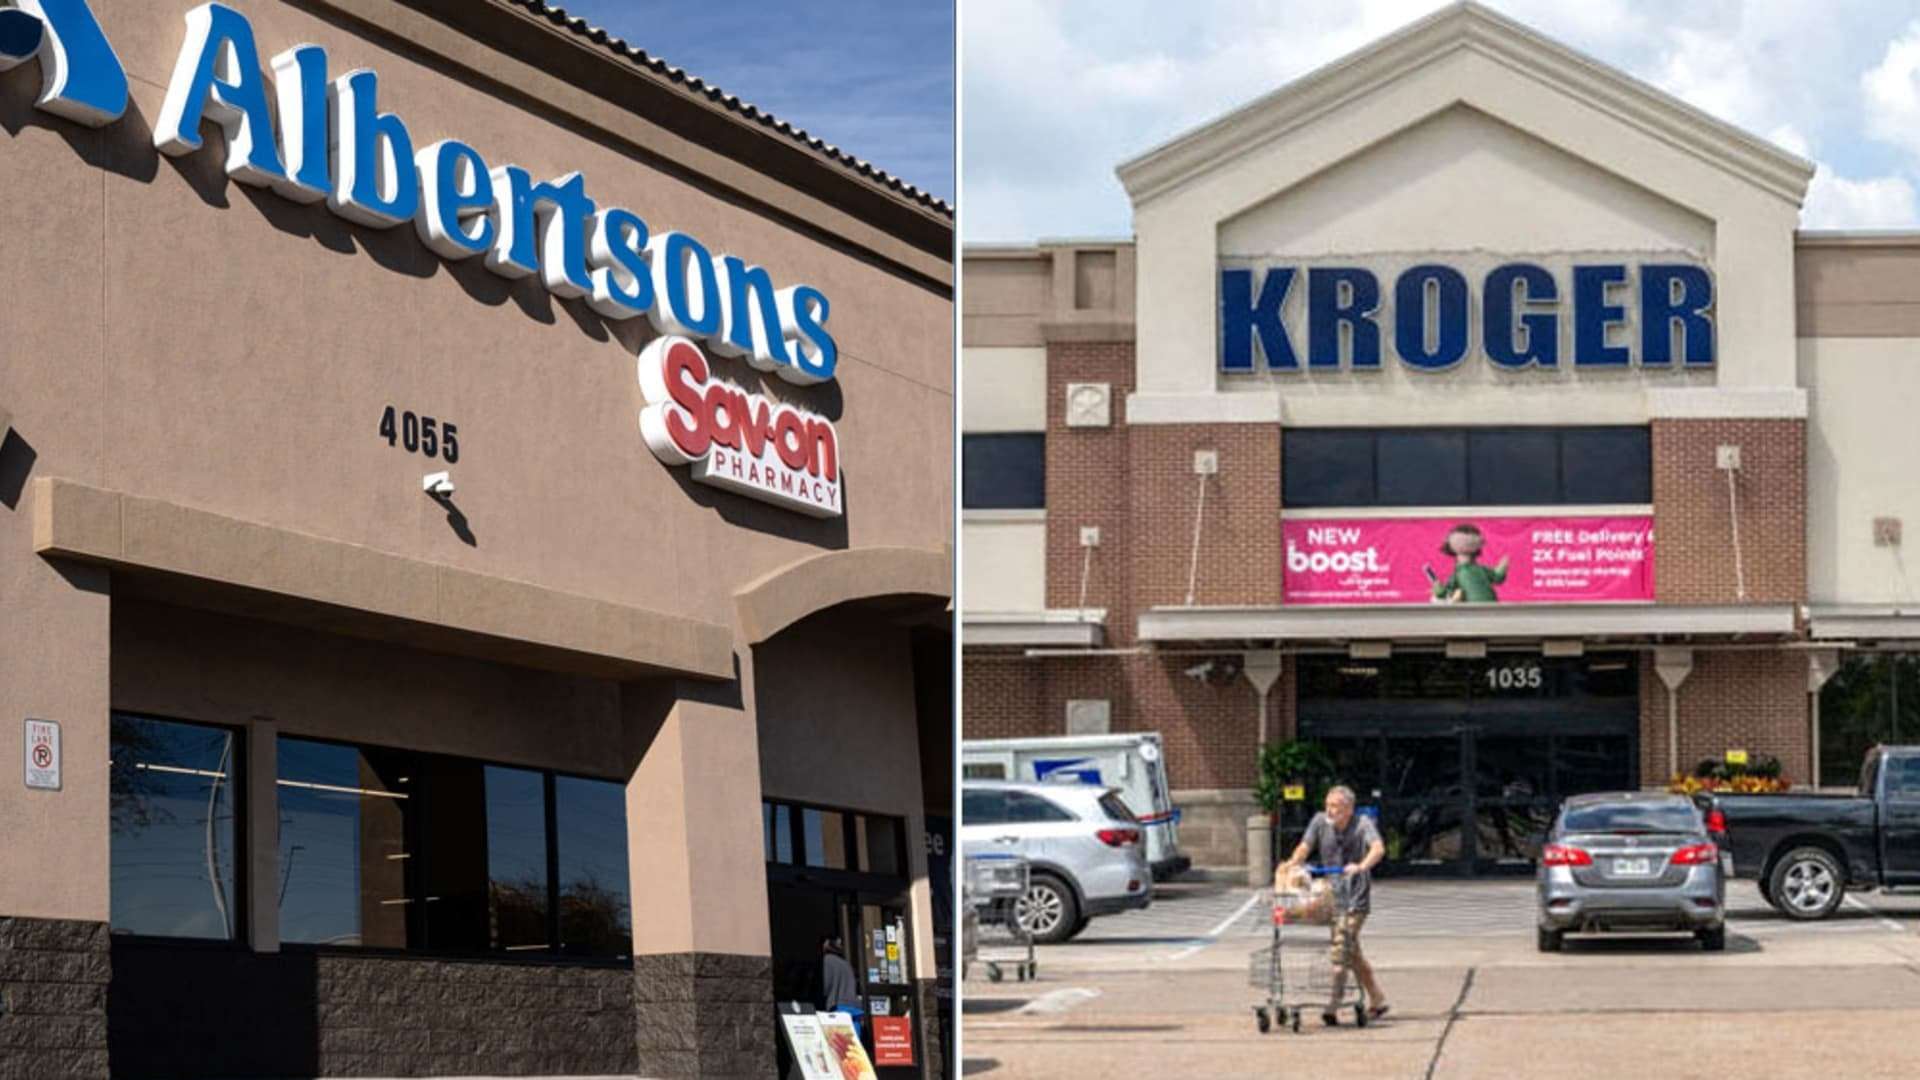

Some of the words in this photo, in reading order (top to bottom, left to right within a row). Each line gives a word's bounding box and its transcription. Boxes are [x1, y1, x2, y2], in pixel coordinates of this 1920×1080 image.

[155, 3, 837, 385] Albertsons
[1220, 263, 1717, 373] KROGER
[379, 405, 459, 465] 4055
[715, 451, 837, 507] PHARMACY
[1307, 527, 1361, 545] NEW
[1532, 529, 1574, 544] FREE
[1578, 527, 1644, 546] Delivery
[1532, 549, 1553, 562] 2X
[1557, 548, 1592, 562] Fuel
[1595, 547, 1644, 562] Points
[1486, 667, 1543, 689] 1035
